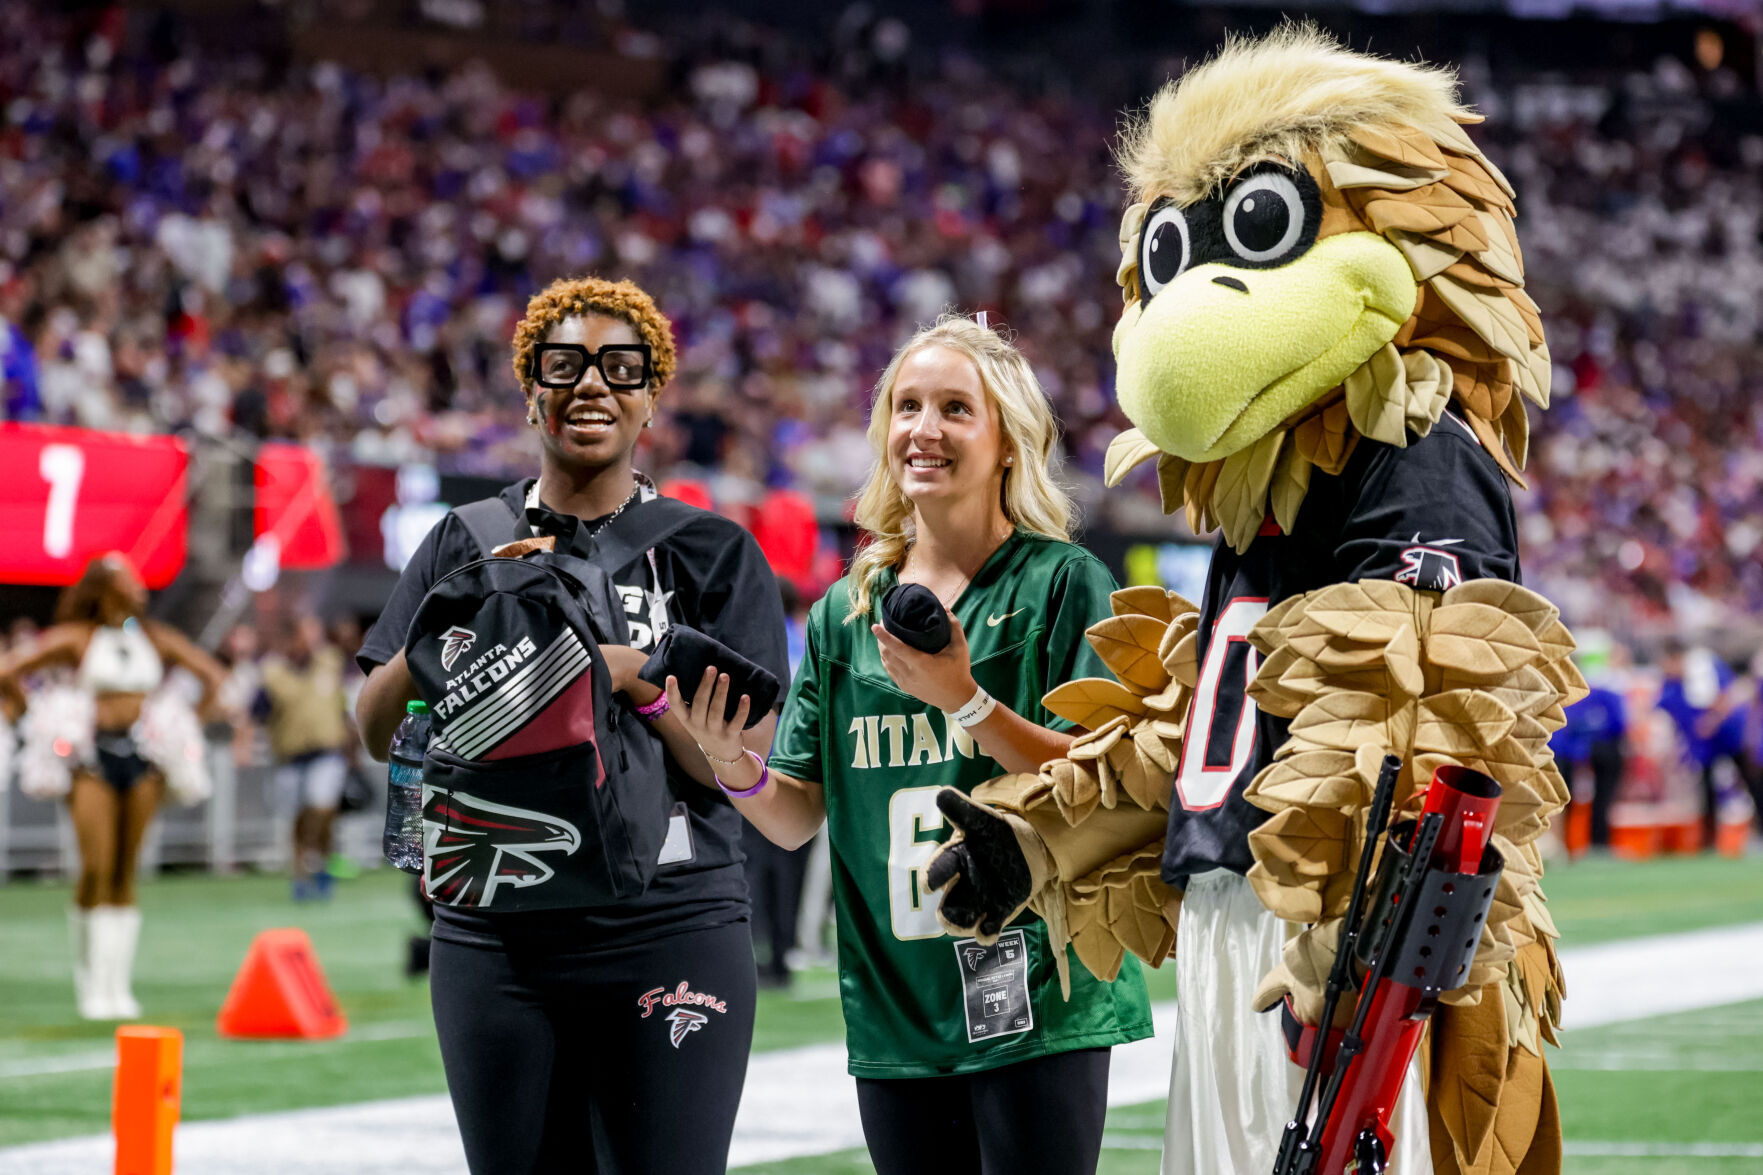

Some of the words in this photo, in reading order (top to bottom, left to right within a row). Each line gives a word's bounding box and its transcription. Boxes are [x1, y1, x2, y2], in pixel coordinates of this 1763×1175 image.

[433, 635, 537, 720] FALCONS
[446, 643, 508, 691] ATLANTA
[848, 711, 992, 769] TITAN
[887, 784, 949, 942] 6
[998, 940, 1019, 948] WEEK
[638, 981, 727, 1018] Falcons
[984, 990, 1007, 1004] ZONE
[993, 1002, 1000, 1013] 3
